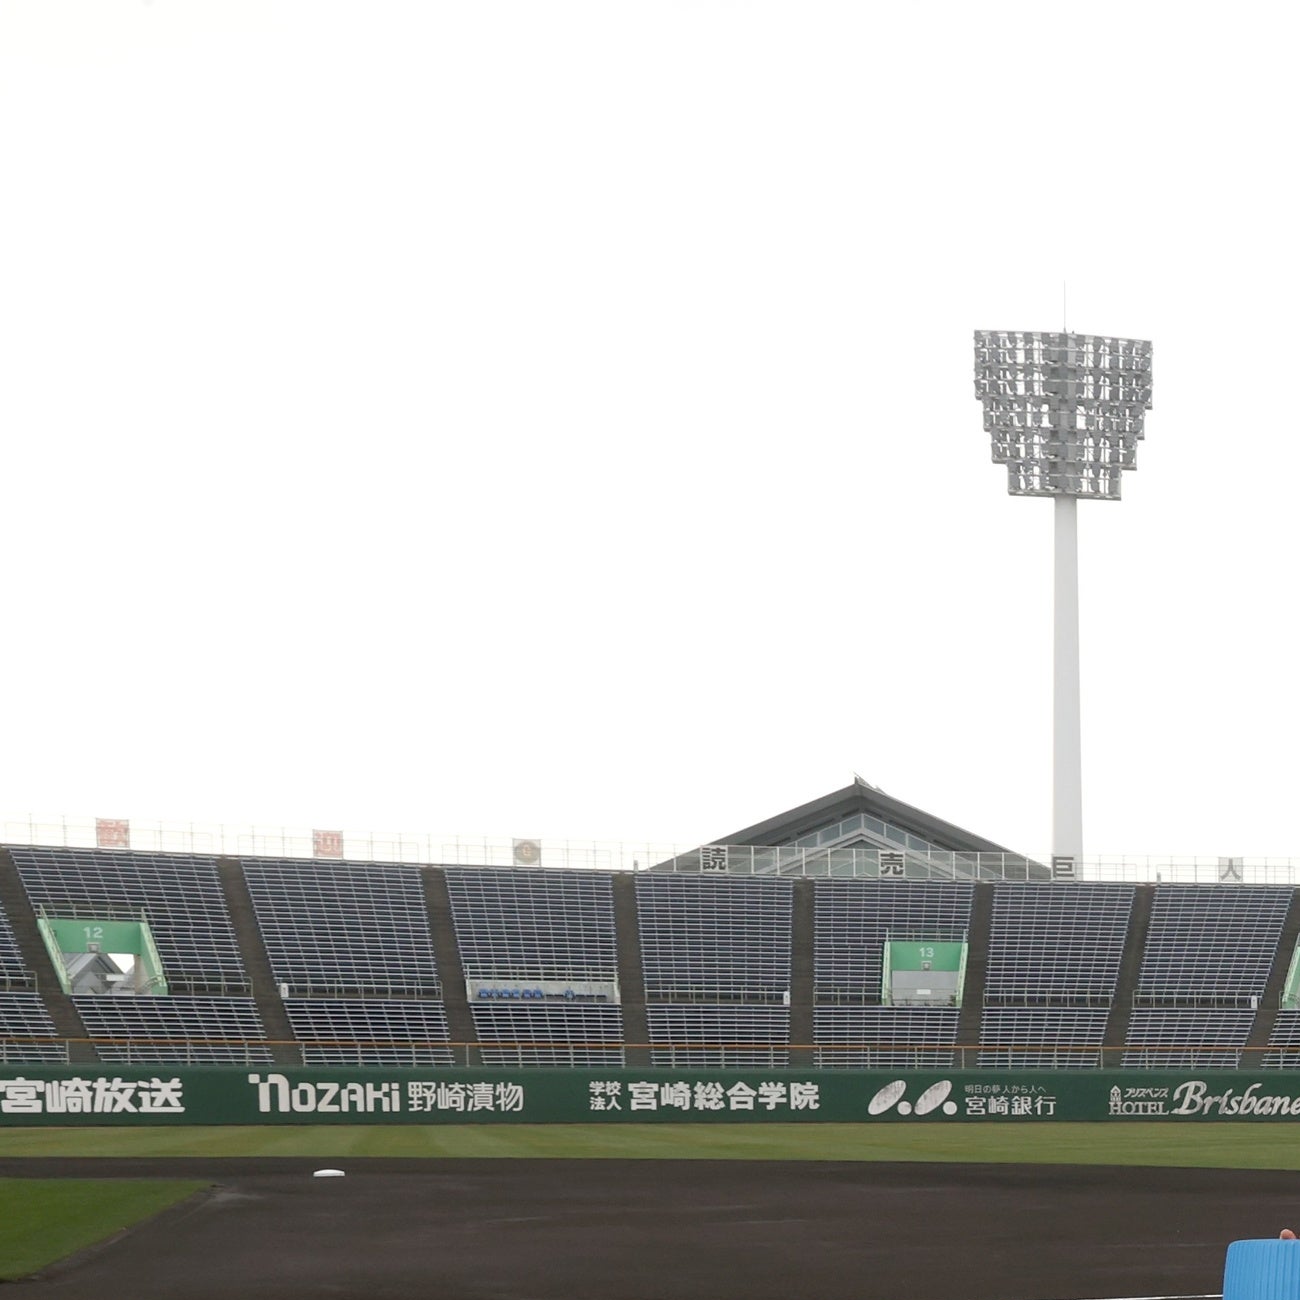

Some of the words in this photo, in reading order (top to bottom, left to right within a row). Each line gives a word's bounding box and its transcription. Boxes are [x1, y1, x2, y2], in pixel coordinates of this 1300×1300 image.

[702, 847, 727, 871] 読
[880, 852, 905, 876] 売
[1053, 857, 1075, 878] 巨
[1221, 858, 1241, 881] 人
[83, 926, 104, 939] 12
[919, 947, 934, 958] 13
[0, 1077, 186, 1113] 宮崎放送
[407, 1081, 524, 1112] 野崎漬物
[589, 1081, 622, 1096] 学校
[627, 1081, 820, 1111] 宮崎総合学院
[589, 1096, 622, 1111] 法人
[964, 1095, 1057, 1116] 宮崎銀行
[1108, 1101, 1169, 1116] HOTEL
